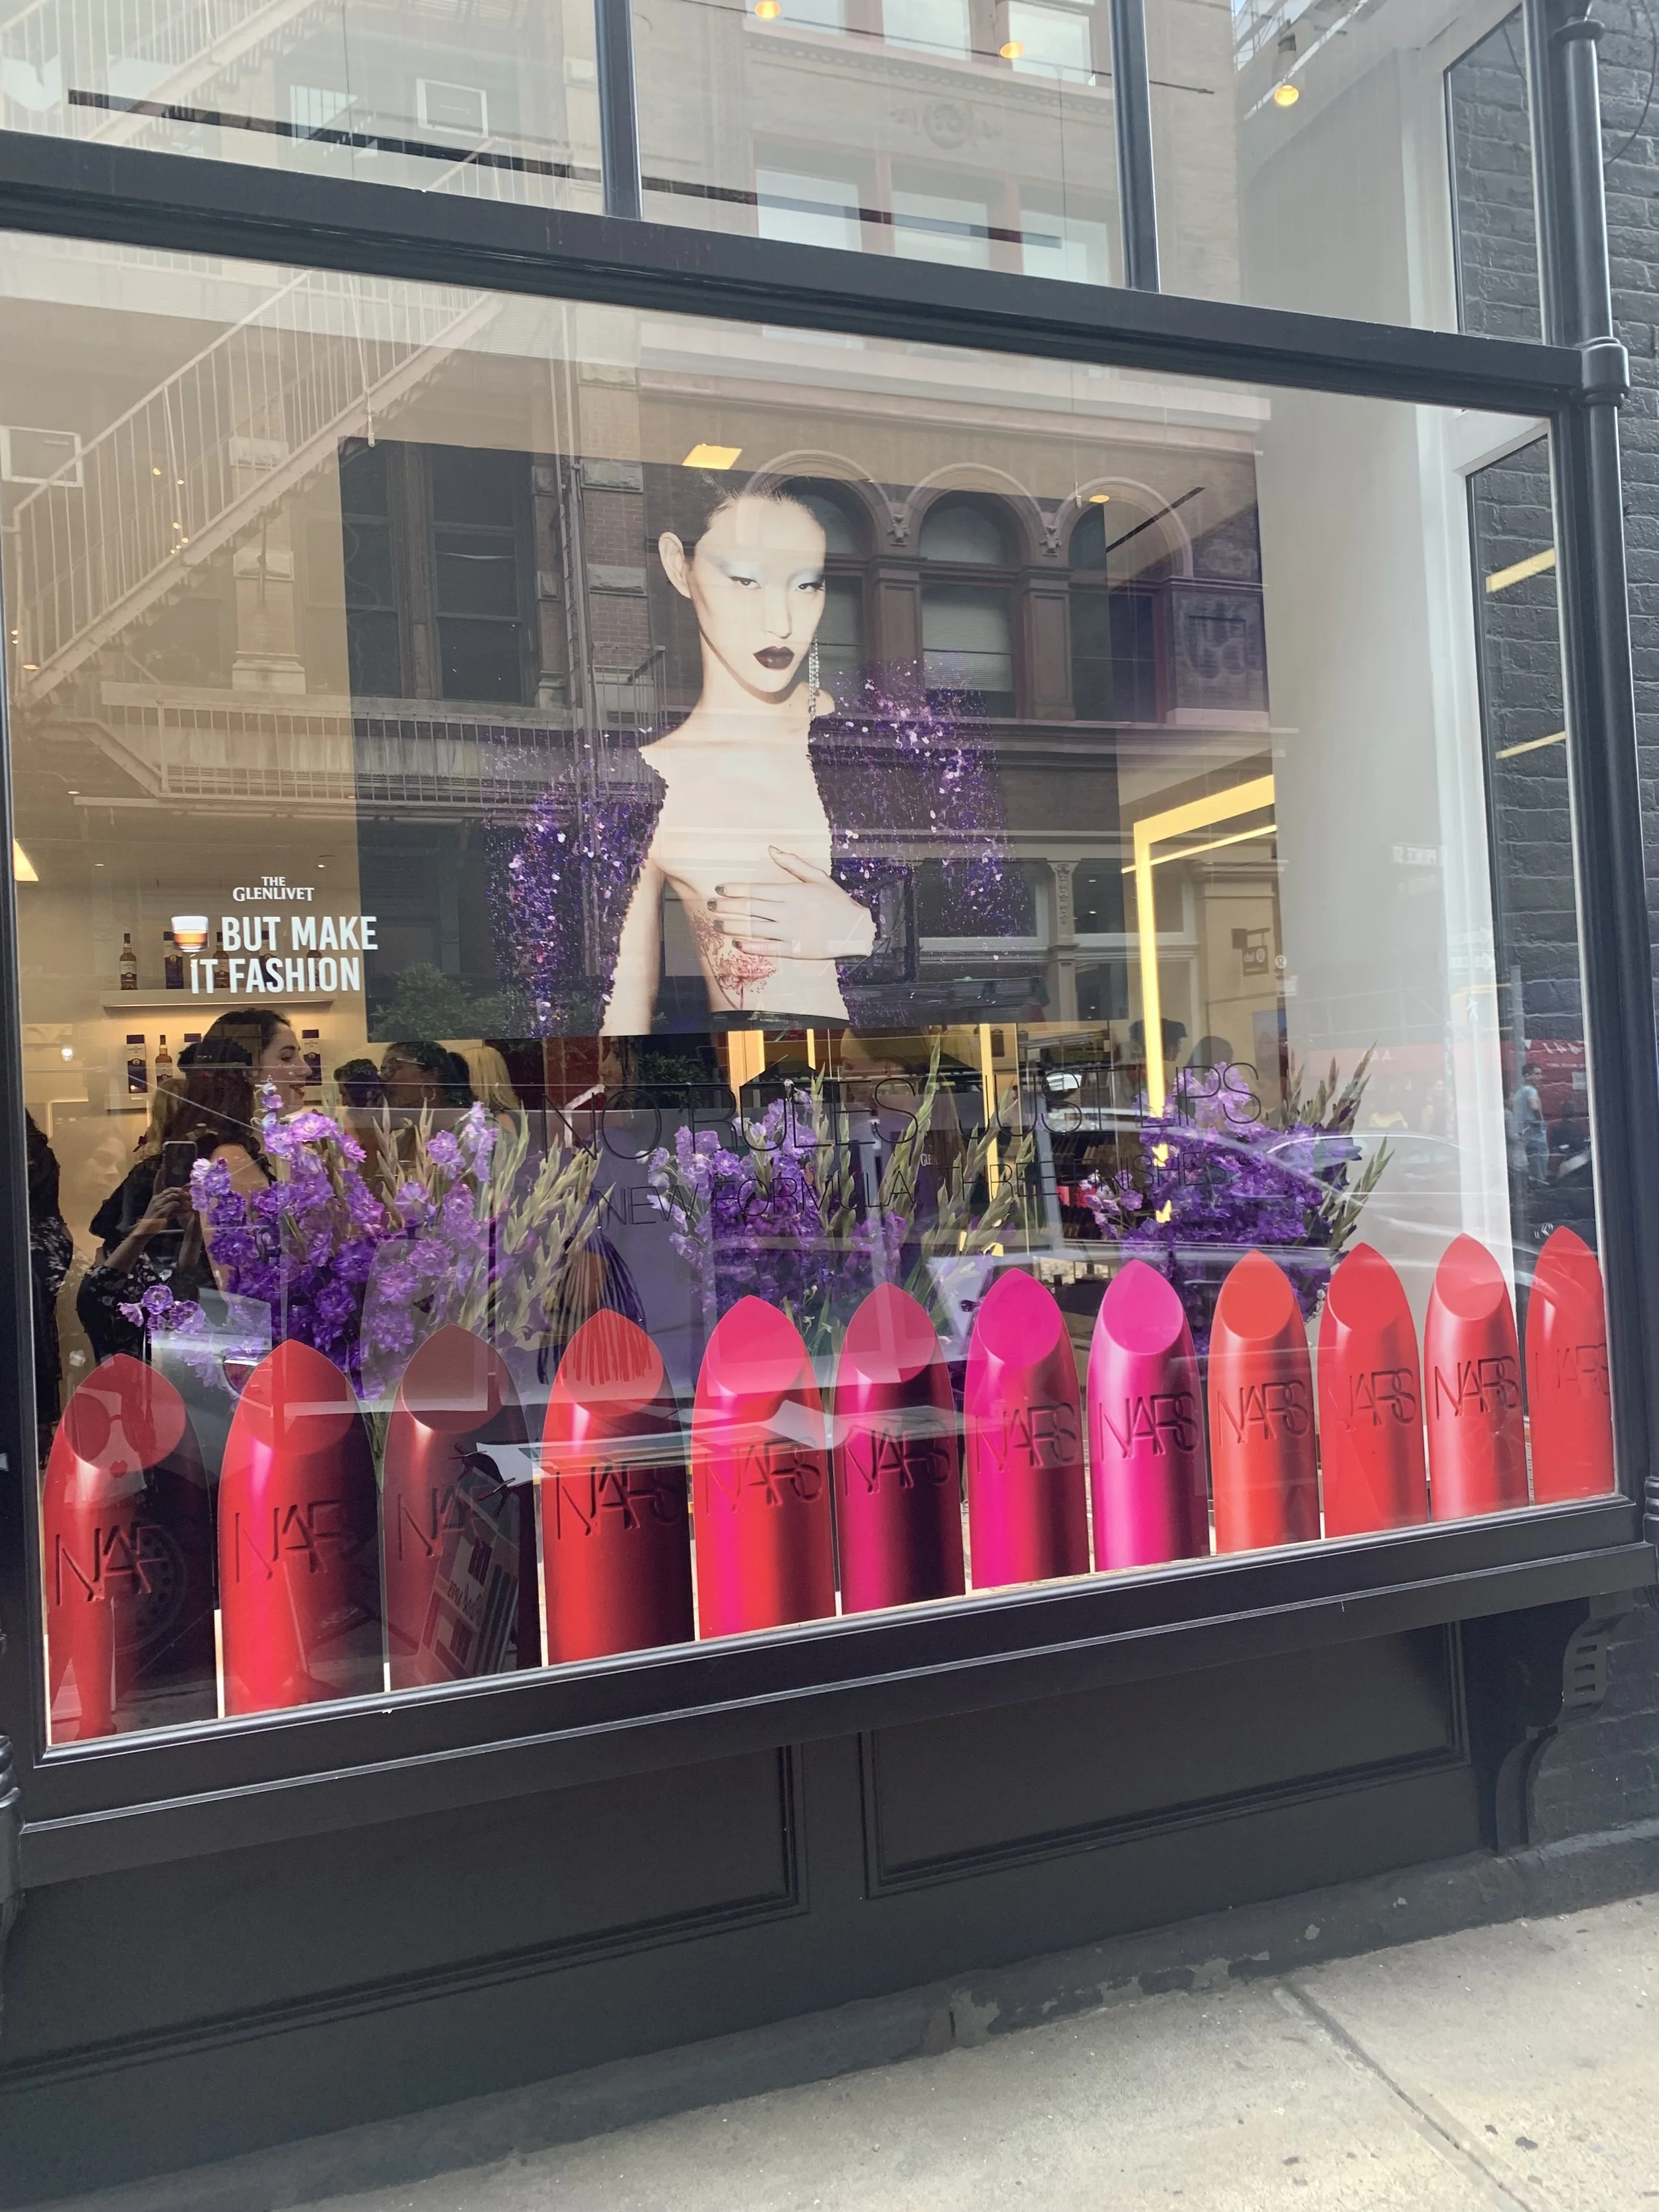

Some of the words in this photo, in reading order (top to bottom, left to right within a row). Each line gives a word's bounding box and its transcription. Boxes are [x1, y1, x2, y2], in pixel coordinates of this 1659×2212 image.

[232, 887, 315, 902] GLENLIVET
[261, 876, 285, 887] THE
[221, 916, 281, 952] BUT
[291, 916, 378, 950] MAKE
[189, 958, 218, 994] IT
[230, 956, 360, 994] FASHION
[543, 1088, 662, 1163] NO
[959, 1069, 1119, 1139] JUST
[596, 1183, 699, 1226] NEW
[936, 1160, 1062, 1201] THREE
[1216, 1380, 1310, 1445] NARS
[1434, 1355, 1520, 1420] NARS
[844, 1420, 951, 1497] NARS
[975, 1402, 1077, 1474] NARS
[1098, 1391, 1199, 1461] NARS
[704, 1436, 822, 1515] NARS
